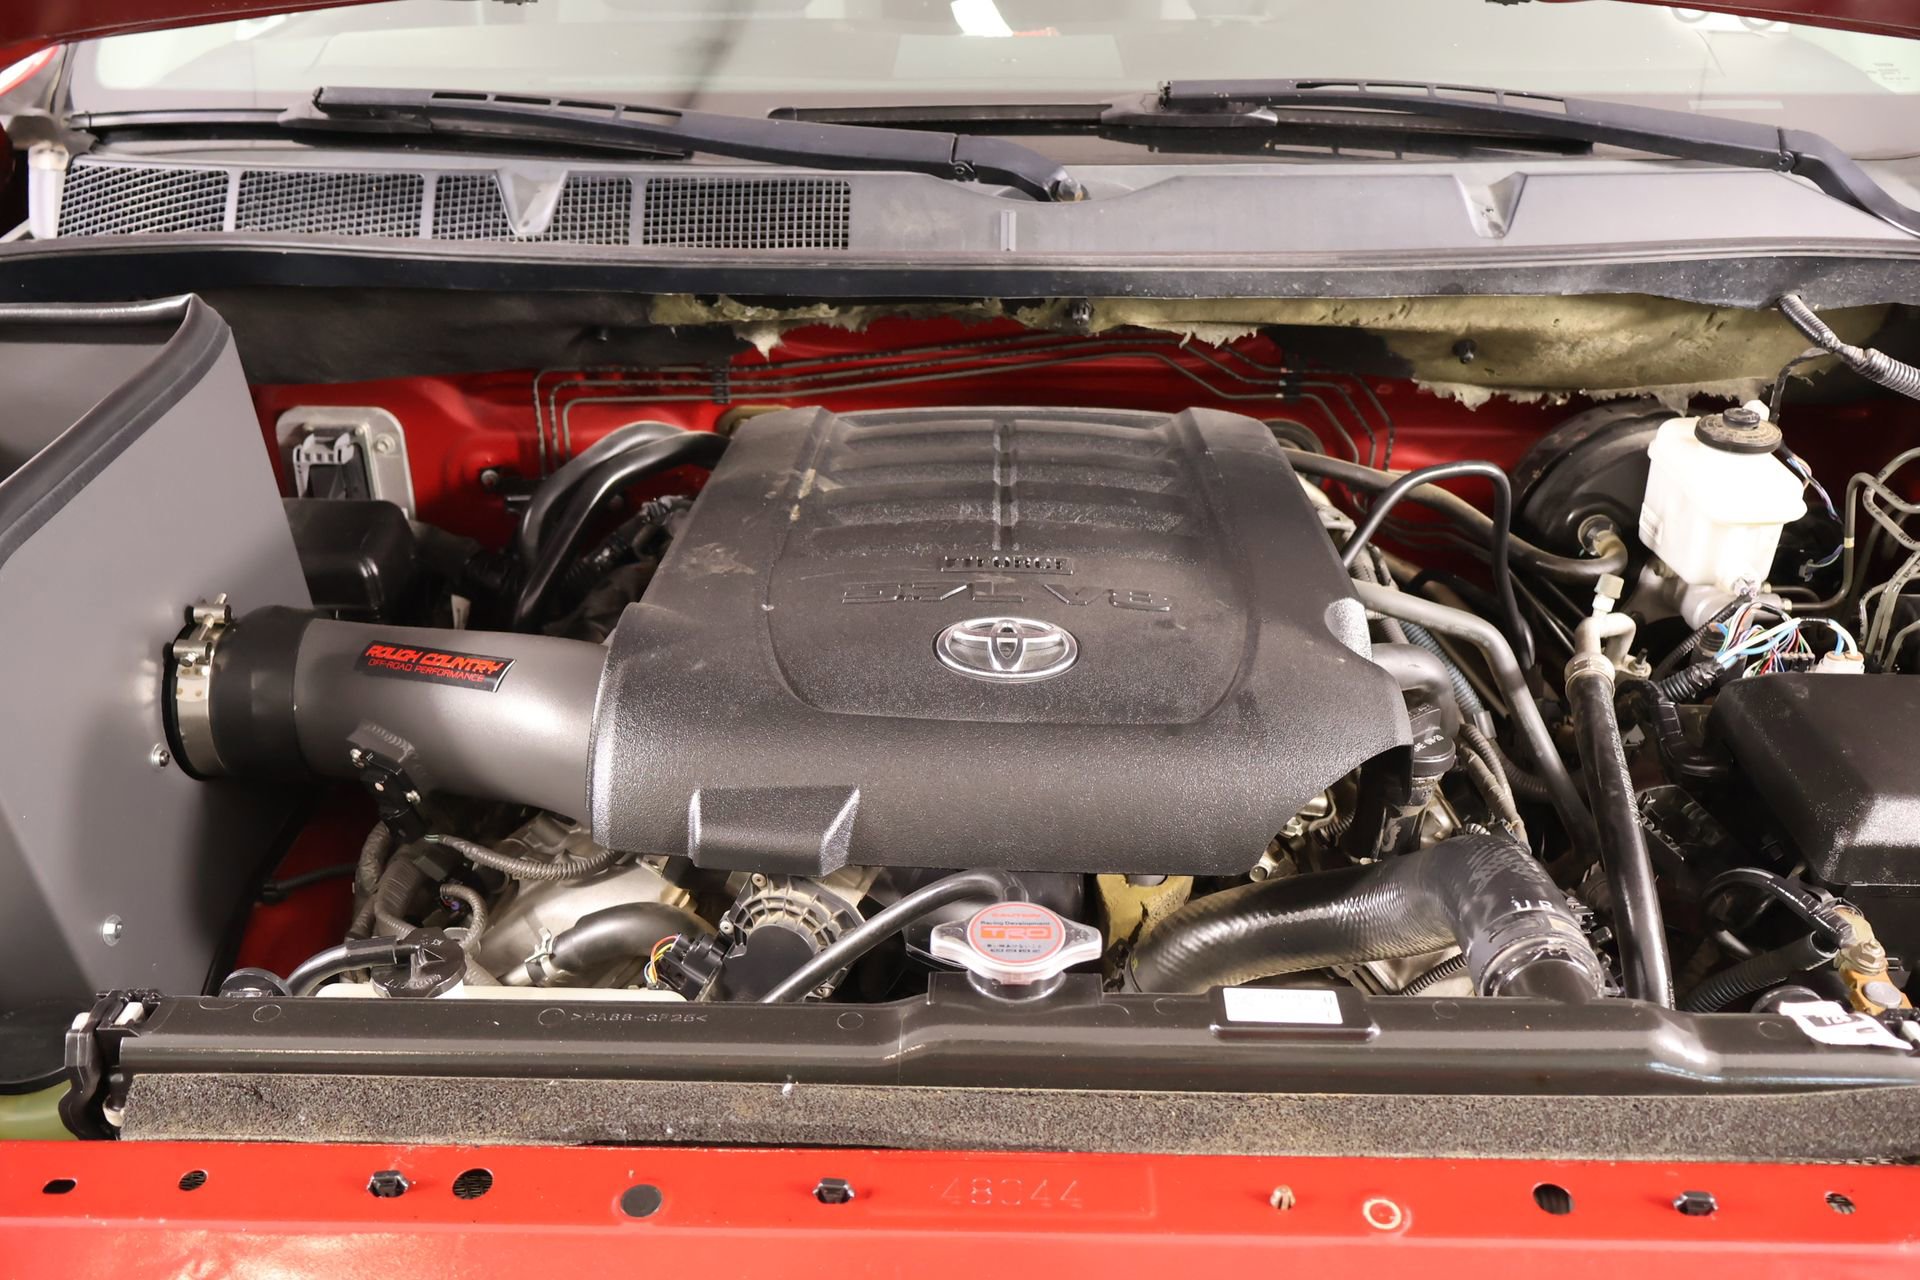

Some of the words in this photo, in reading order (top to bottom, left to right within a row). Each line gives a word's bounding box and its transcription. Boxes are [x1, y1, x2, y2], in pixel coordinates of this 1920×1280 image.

[365, 645, 423, 662] ROUGH
[420, 653, 504, 675] COUNTRY
[368, 658, 413, 672] OFF-ROAD
[414, 665, 485, 682] PERFORMANCE
[980, 926, 1053, 940] TRD
